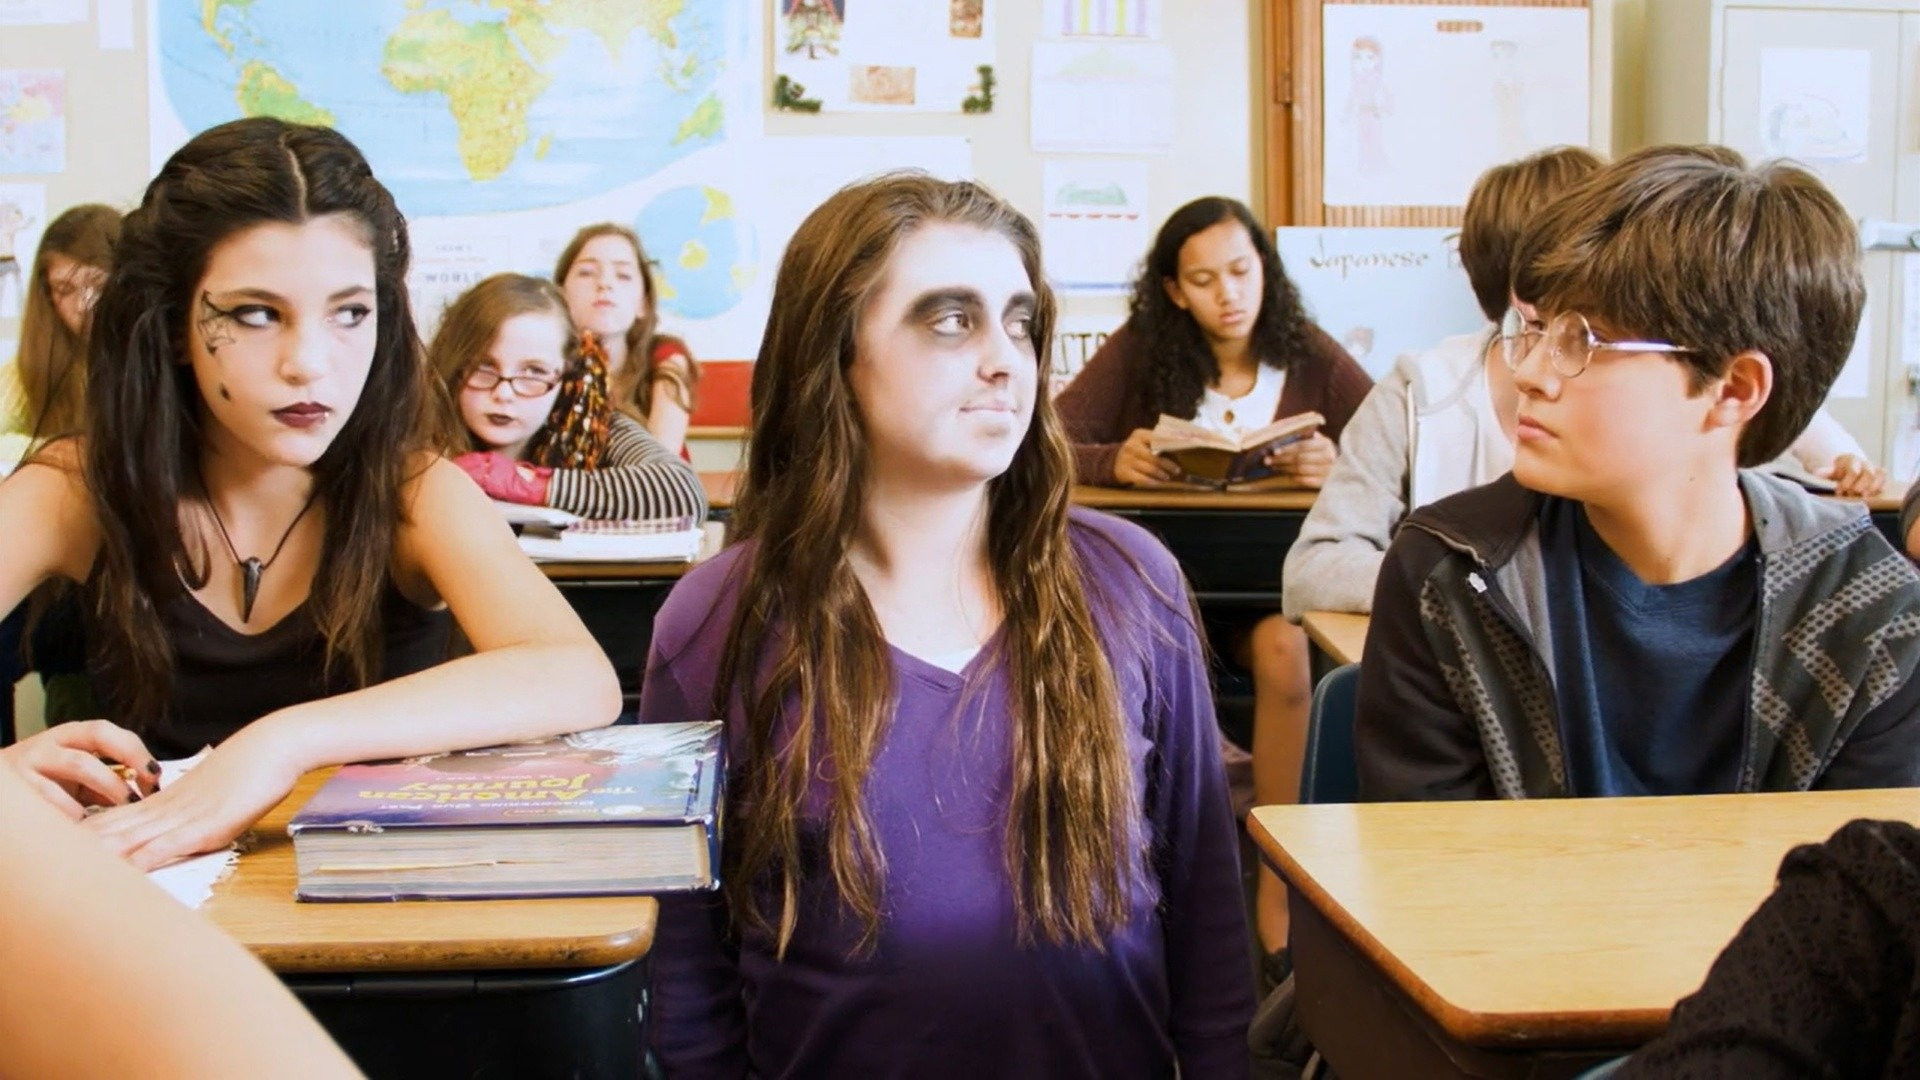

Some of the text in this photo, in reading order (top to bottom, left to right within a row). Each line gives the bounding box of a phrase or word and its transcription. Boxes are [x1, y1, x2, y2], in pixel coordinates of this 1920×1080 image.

[1309, 233, 1428, 281] Japanese
[400, 772, 590, 791] Journey
[358, 785, 637, 804] The American
